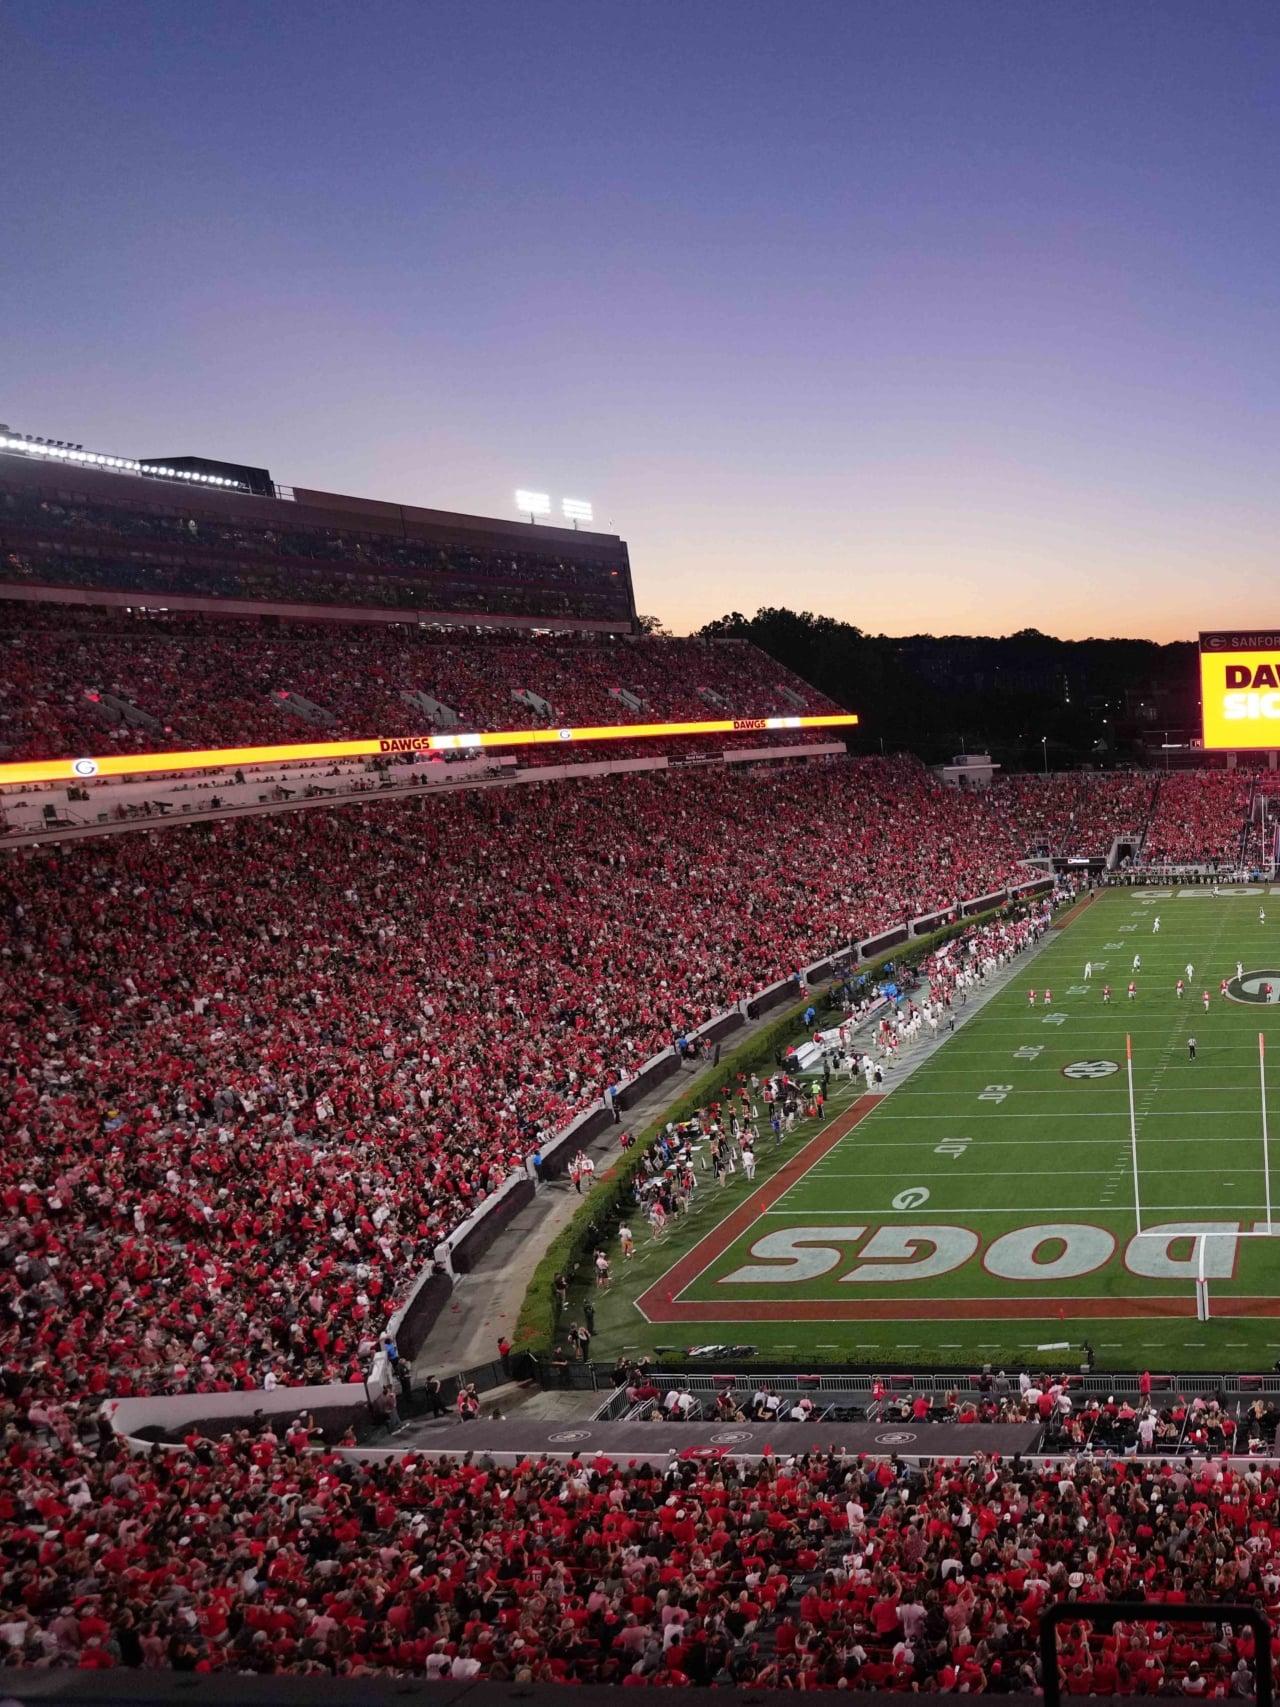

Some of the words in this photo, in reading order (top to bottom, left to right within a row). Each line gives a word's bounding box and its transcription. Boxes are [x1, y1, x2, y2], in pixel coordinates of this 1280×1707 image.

[734, 719, 766, 730] DAWGS
[380, 738, 430, 752] DAWGS
[1013, 1045, 1045, 1058] 30
[977, 1084, 1014, 1102] 20
[934, 1137, 973, 1155] 10
